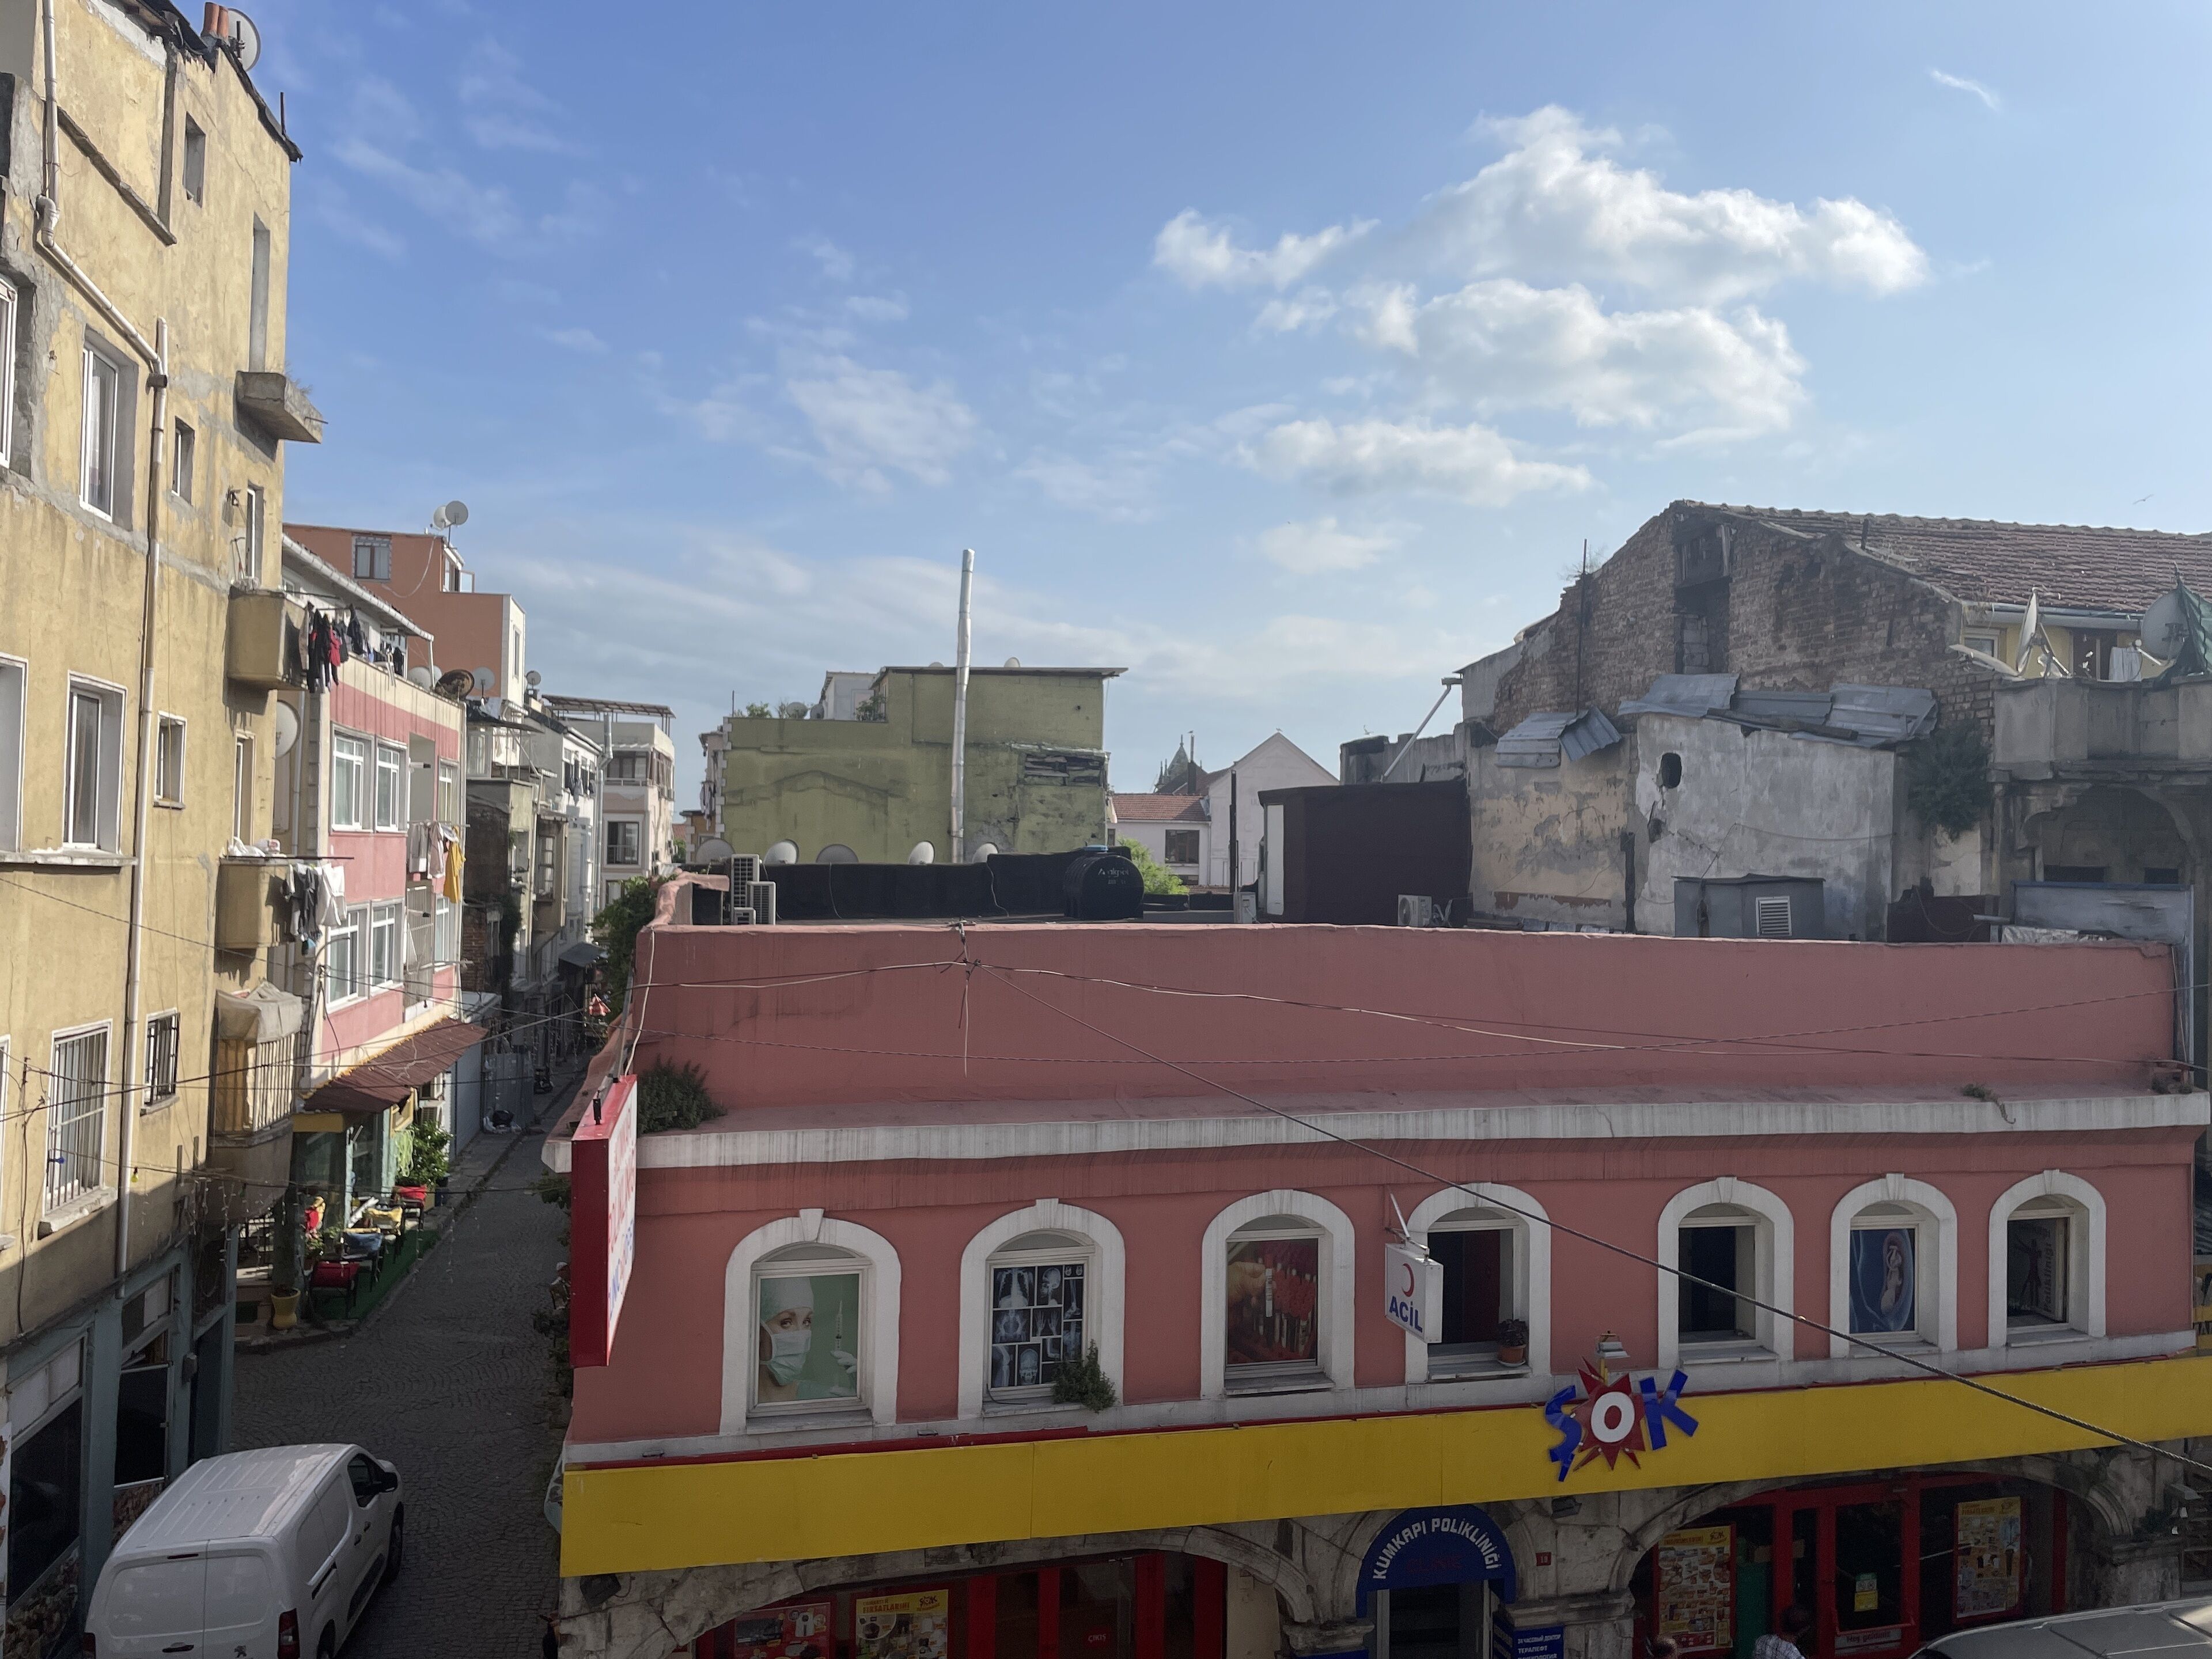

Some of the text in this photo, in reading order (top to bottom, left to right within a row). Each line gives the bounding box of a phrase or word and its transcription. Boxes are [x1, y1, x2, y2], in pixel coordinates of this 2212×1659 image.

[1389, 1295, 1422, 1332] ACİL
[1545, 1369, 1699, 1482] ŞOK
[1373, 1517, 1502, 1579] KUMKAPI POLİKLİNİĞİ
